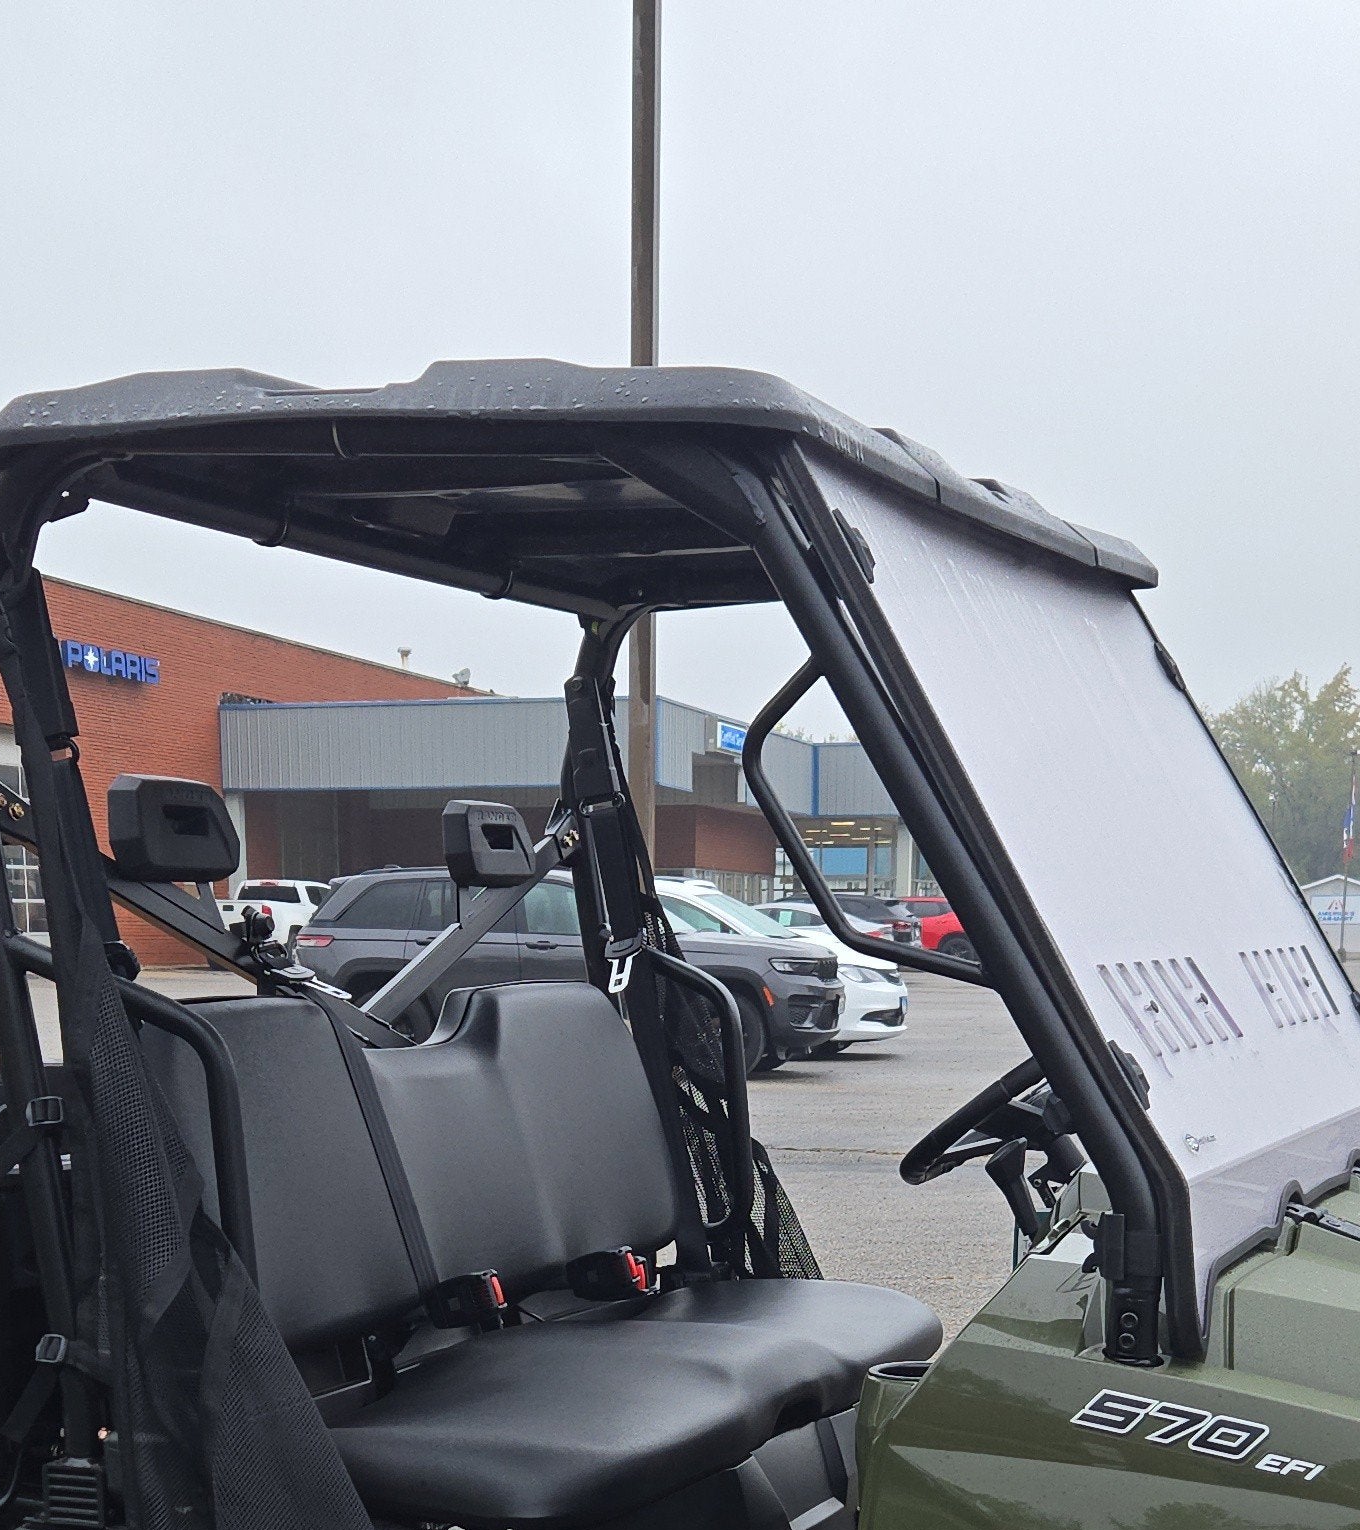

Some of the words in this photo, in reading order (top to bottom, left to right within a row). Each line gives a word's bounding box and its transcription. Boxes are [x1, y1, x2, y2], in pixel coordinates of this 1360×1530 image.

[61, 640, 160, 685] POLARIS
[1070, 1388, 1270, 1460] 570
[1255, 1453, 1326, 1481] EFI
